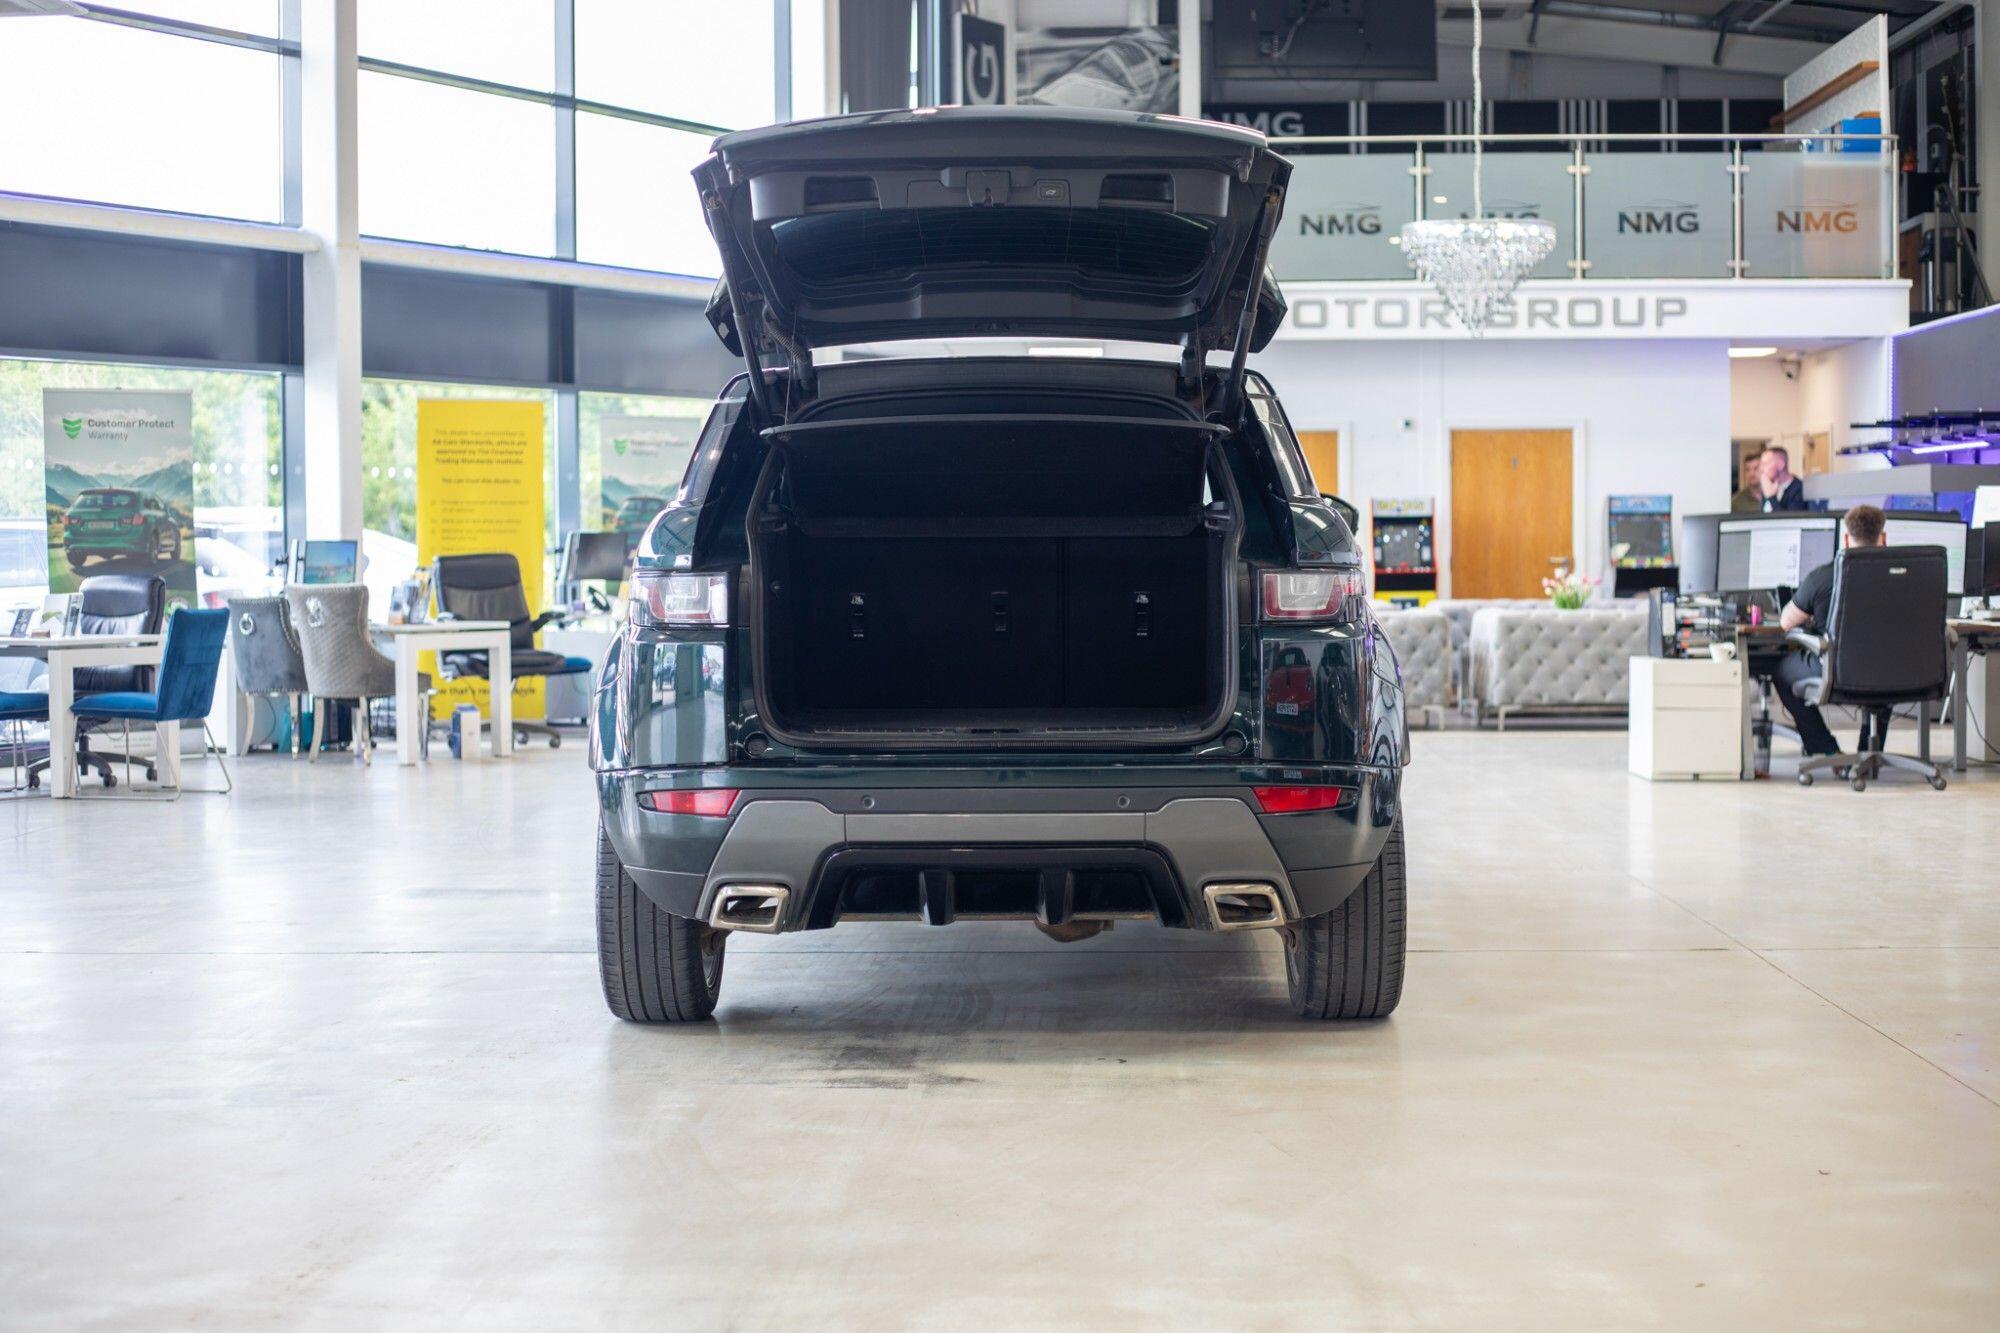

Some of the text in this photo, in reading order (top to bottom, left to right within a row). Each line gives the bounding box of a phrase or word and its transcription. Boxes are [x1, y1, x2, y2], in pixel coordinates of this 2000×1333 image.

[1300, 213, 1383, 235] NMG
[1618, 211, 1699, 233] NMG
[1776, 210, 1858, 233] NMG
[1293, 298, 1686, 328] OTOR GROUP
[87, 419, 175, 429] Customer Protect
[88, 431, 128, 441] Warranty
